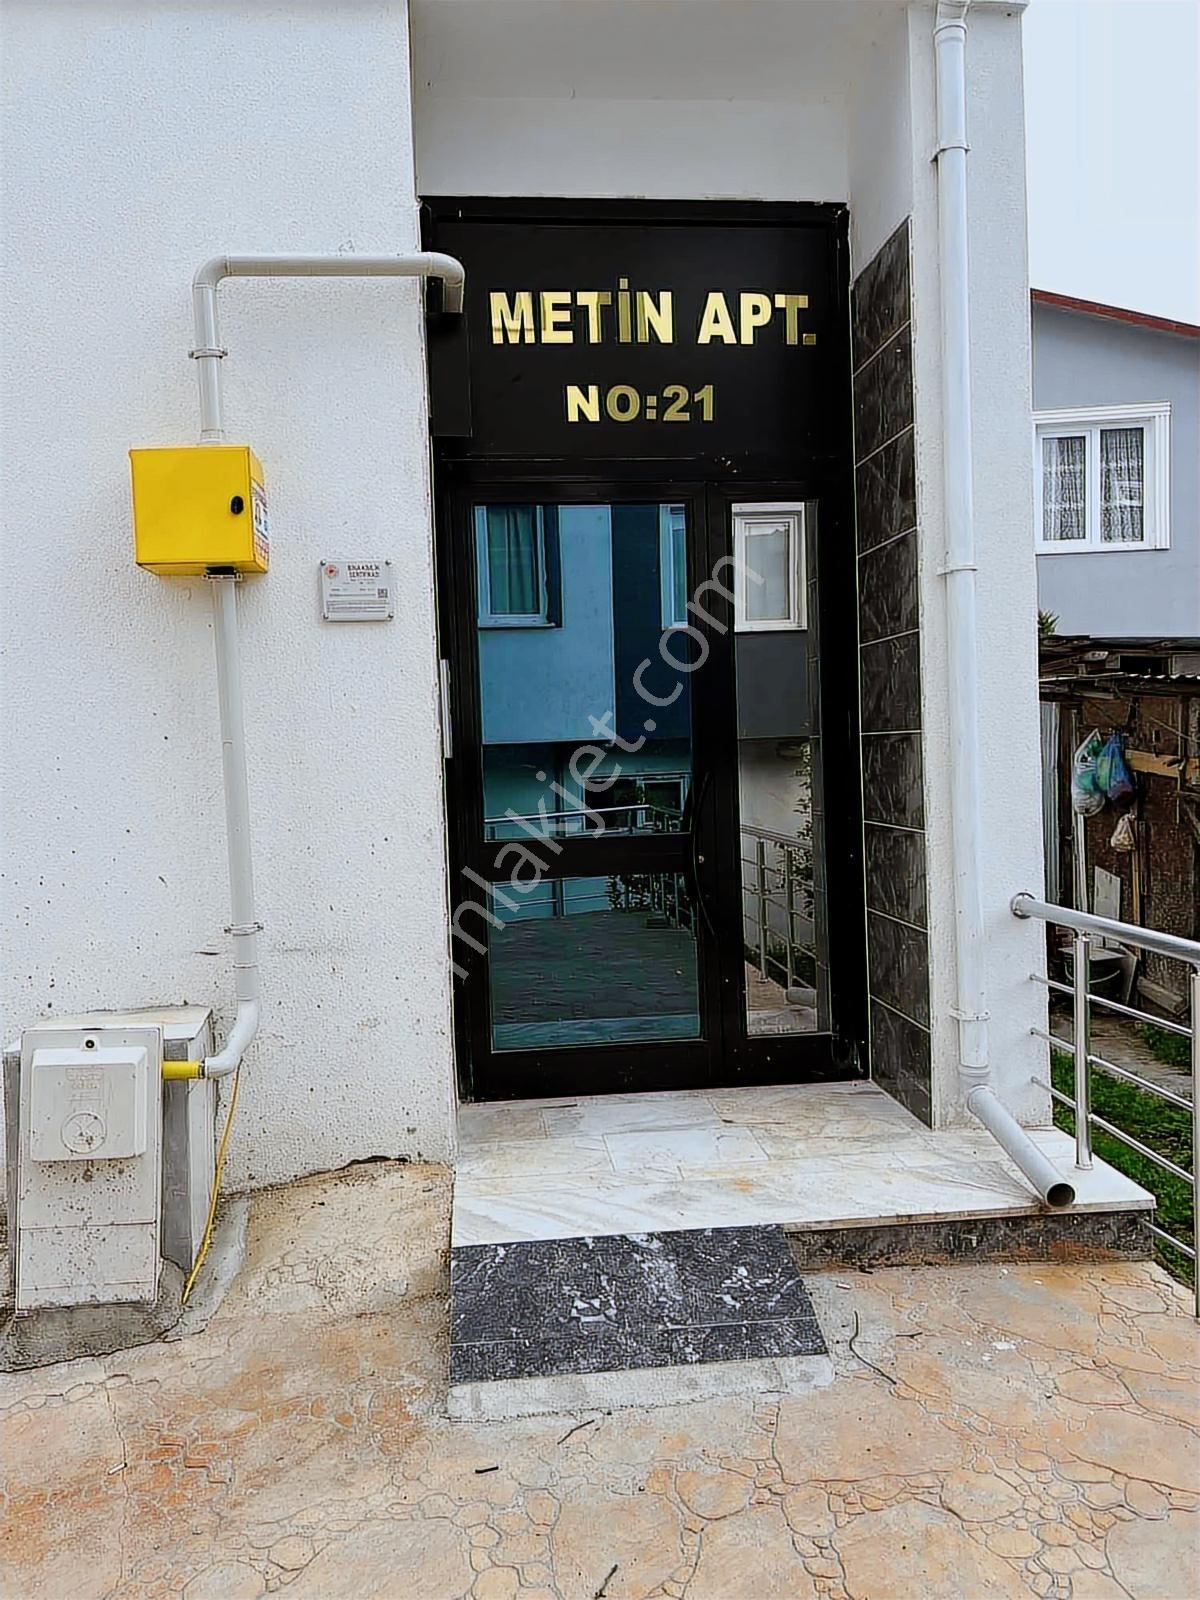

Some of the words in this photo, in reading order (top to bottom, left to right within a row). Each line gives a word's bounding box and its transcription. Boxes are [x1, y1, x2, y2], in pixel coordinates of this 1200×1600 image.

[489, 277, 674, 345] METİN
[697, 291, 817, 346] APT.
[566, 384, 716, 423] NO:21
